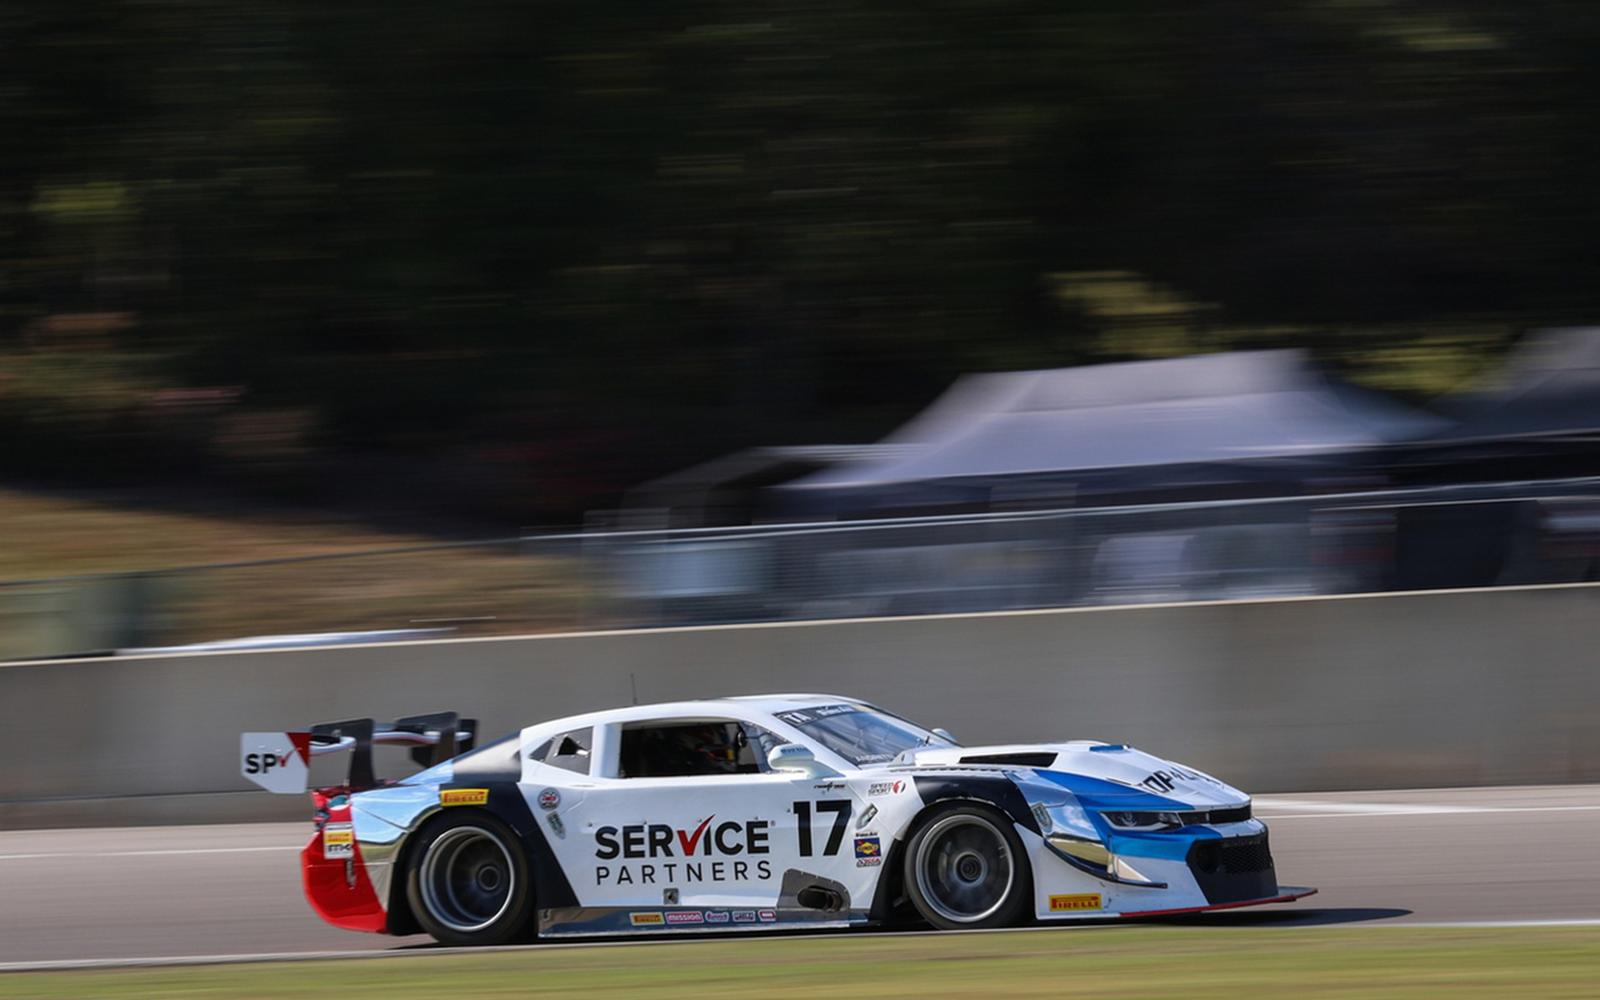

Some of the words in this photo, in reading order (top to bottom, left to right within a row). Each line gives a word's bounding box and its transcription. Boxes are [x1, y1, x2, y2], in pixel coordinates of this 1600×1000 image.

[595, 814, 770, 860] SERVICE
[793, 799, 852, 857] 17
[596, 860, 772, 885] PARTNERS
[1051, 895, 1099, 909] PIRELLI
